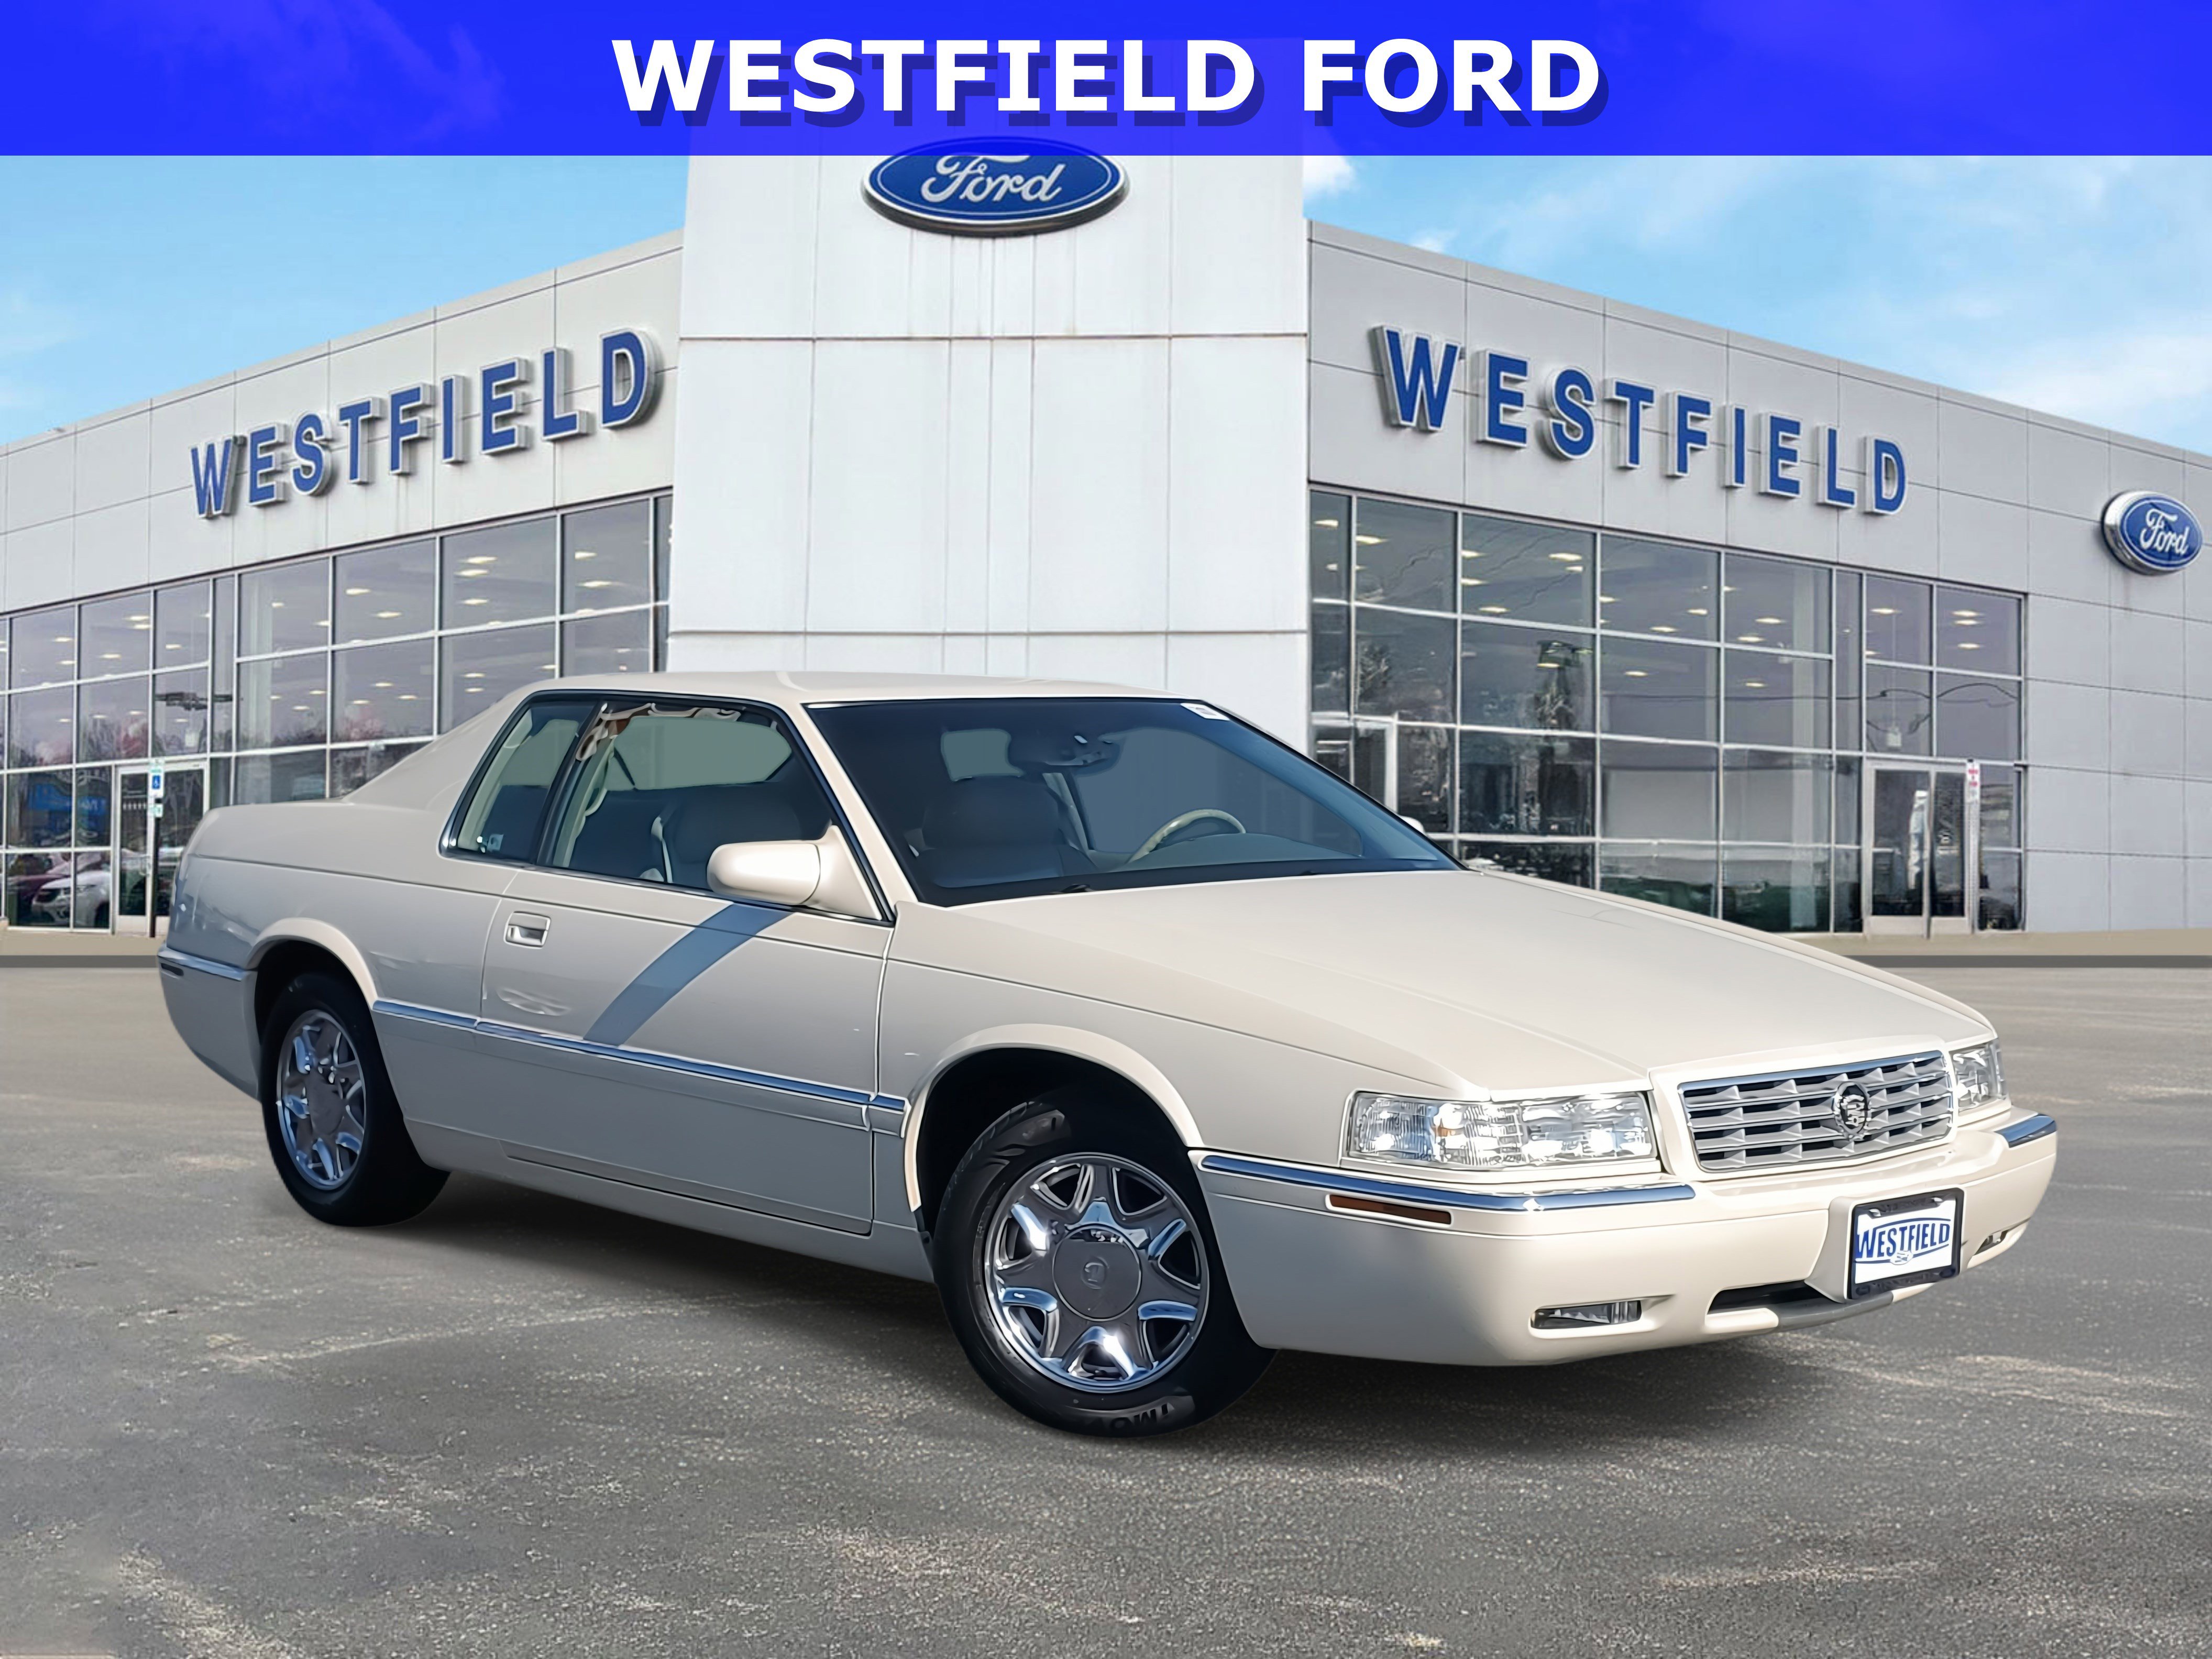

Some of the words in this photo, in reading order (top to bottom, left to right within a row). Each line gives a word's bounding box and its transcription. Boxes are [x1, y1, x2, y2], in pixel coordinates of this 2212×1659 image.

[920, 152, 1066, 203] Ford
[190, 328, 652, 519] WESTFIELD
[1375, 325, 1907, 514] WESTFIELD
[2140, 508, 2190, 555] Ford
[1855, 1223, 1951, 1259] WESTFIELD
